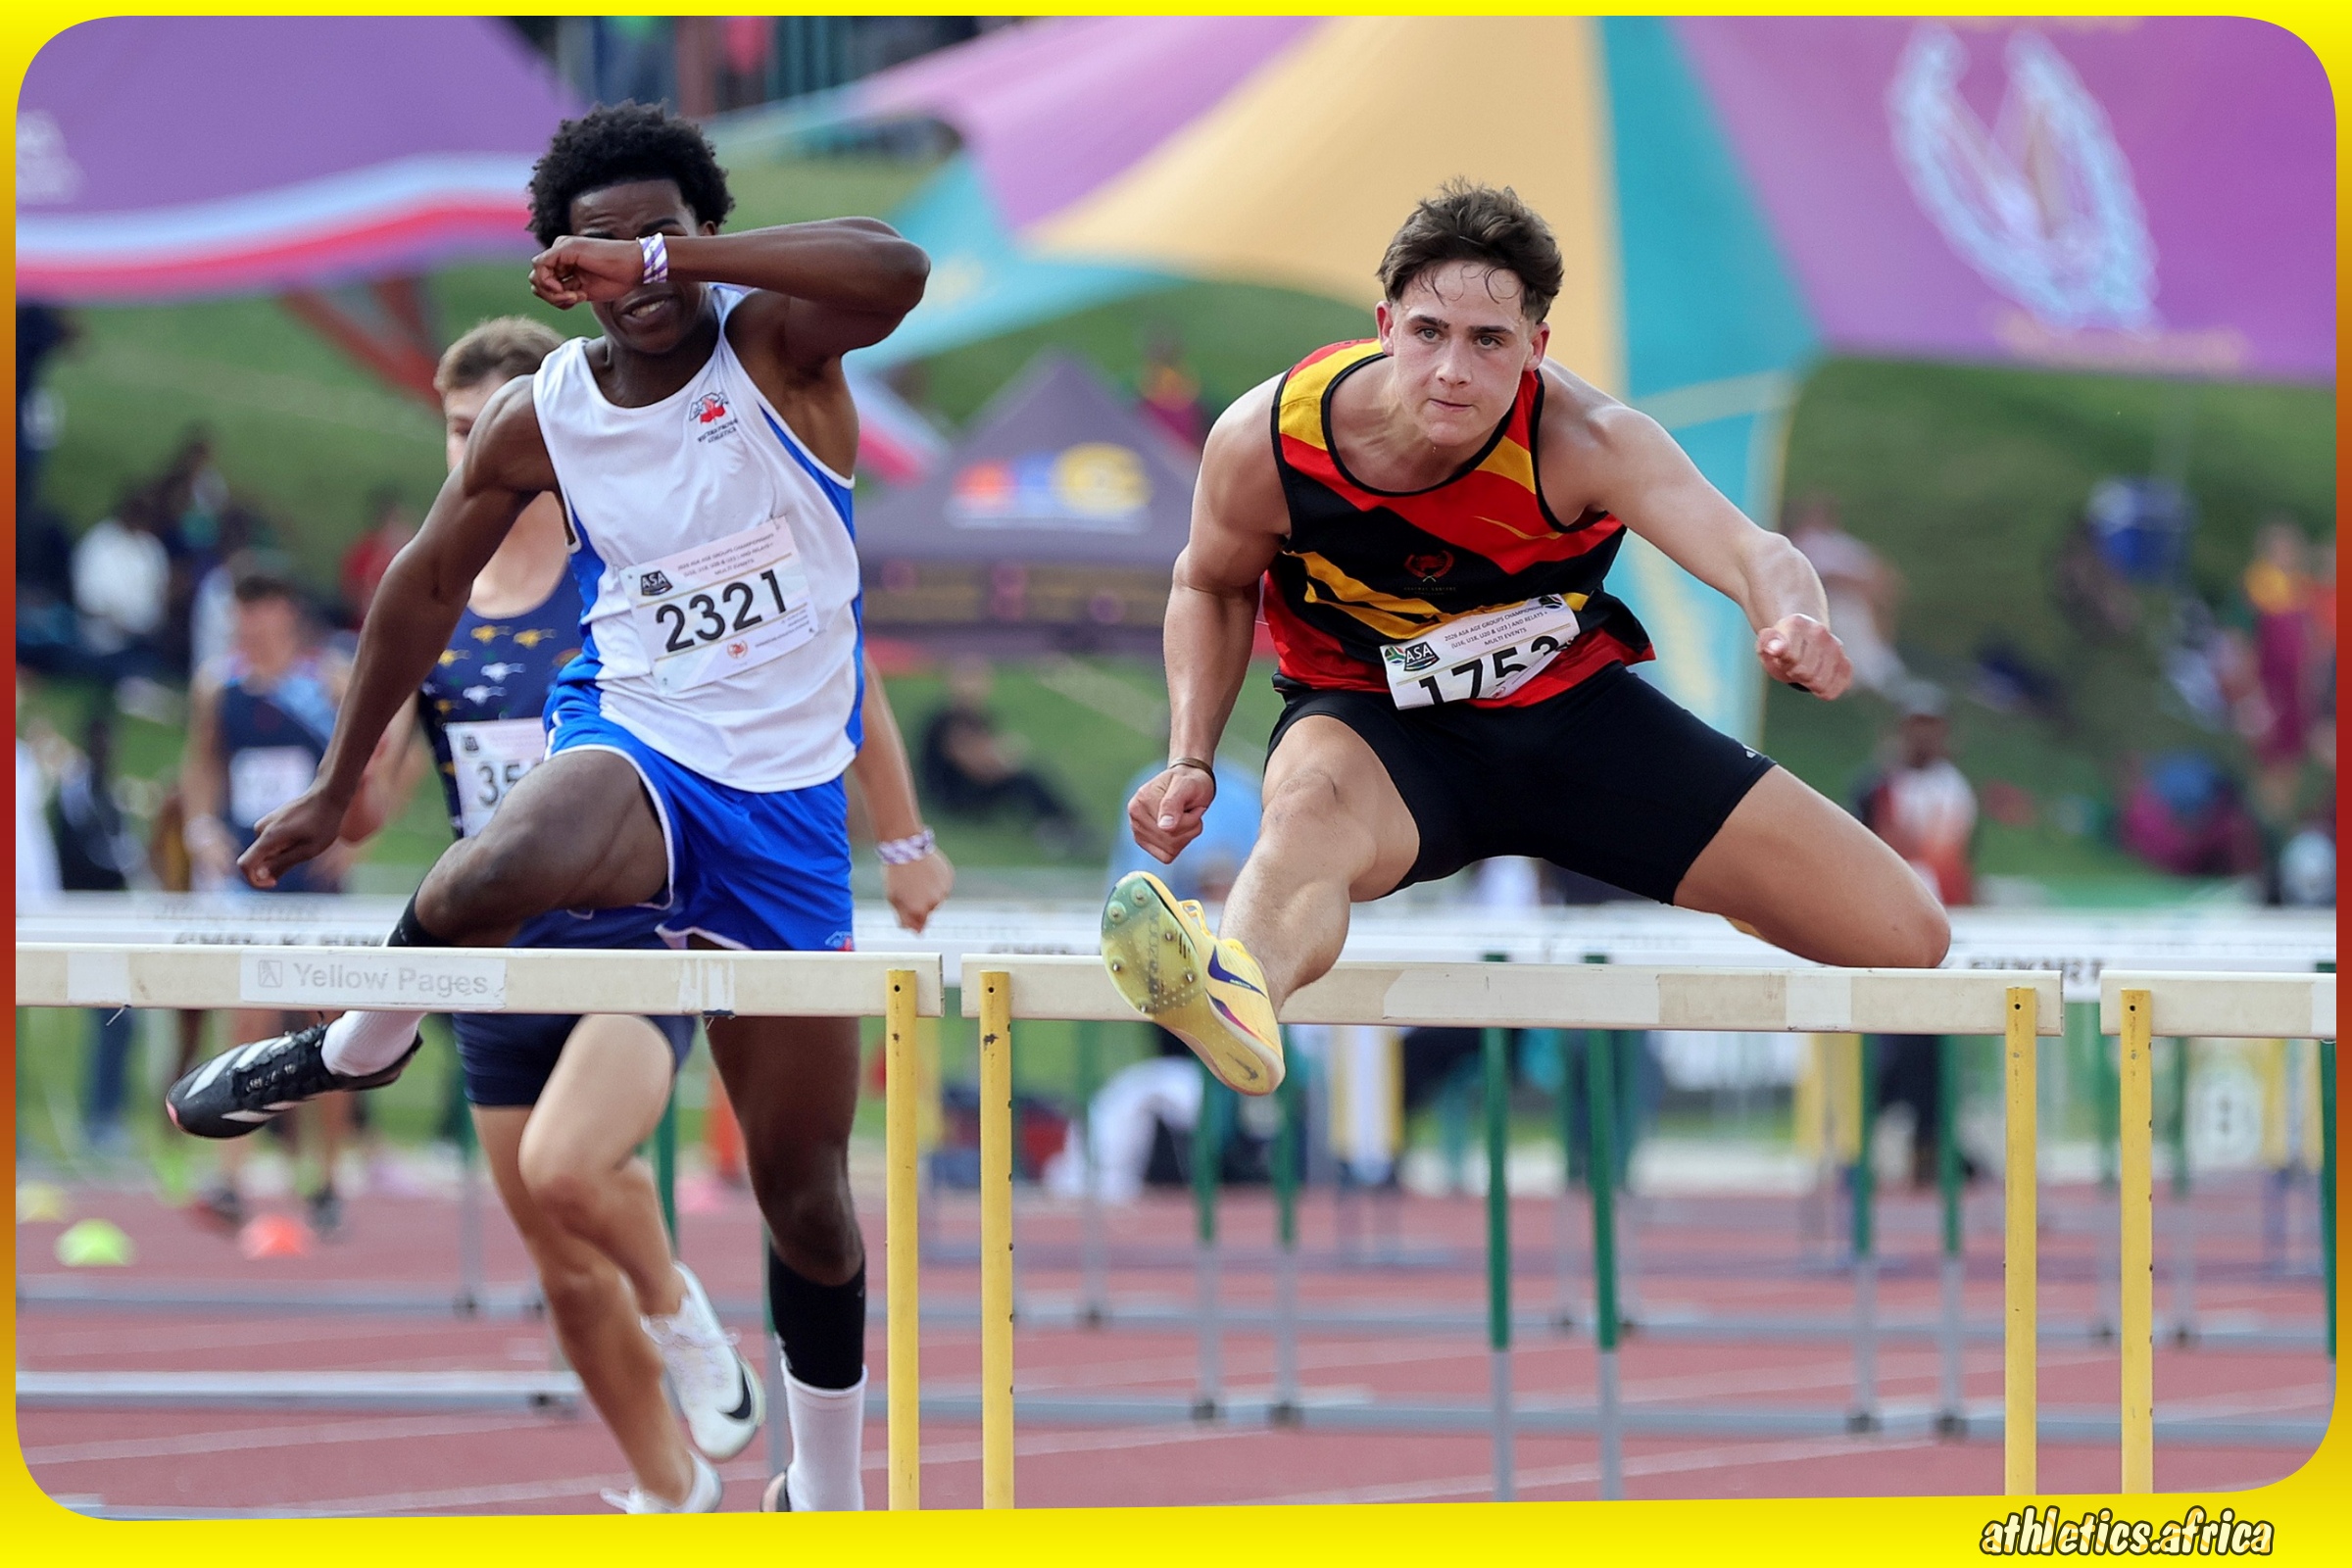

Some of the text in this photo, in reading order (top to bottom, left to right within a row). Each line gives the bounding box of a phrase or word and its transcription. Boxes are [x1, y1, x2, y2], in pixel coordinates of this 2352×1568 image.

[643, 573, 666, 589] ASA
[656, 569, 787, 653] 2321
[1512, 619, 1525, 628] AND
[1525, 611, 1544, 622] RELAYS
[1458, 629, 1470, 638] ASA
[1482, 616, 1504, 630] GROUPS
[1484, 627, 1527, 647] MULTI EVENTS
[1406, 644, 1434, 664] ASA
[294, 962, 489, 998] Yellow Pages
